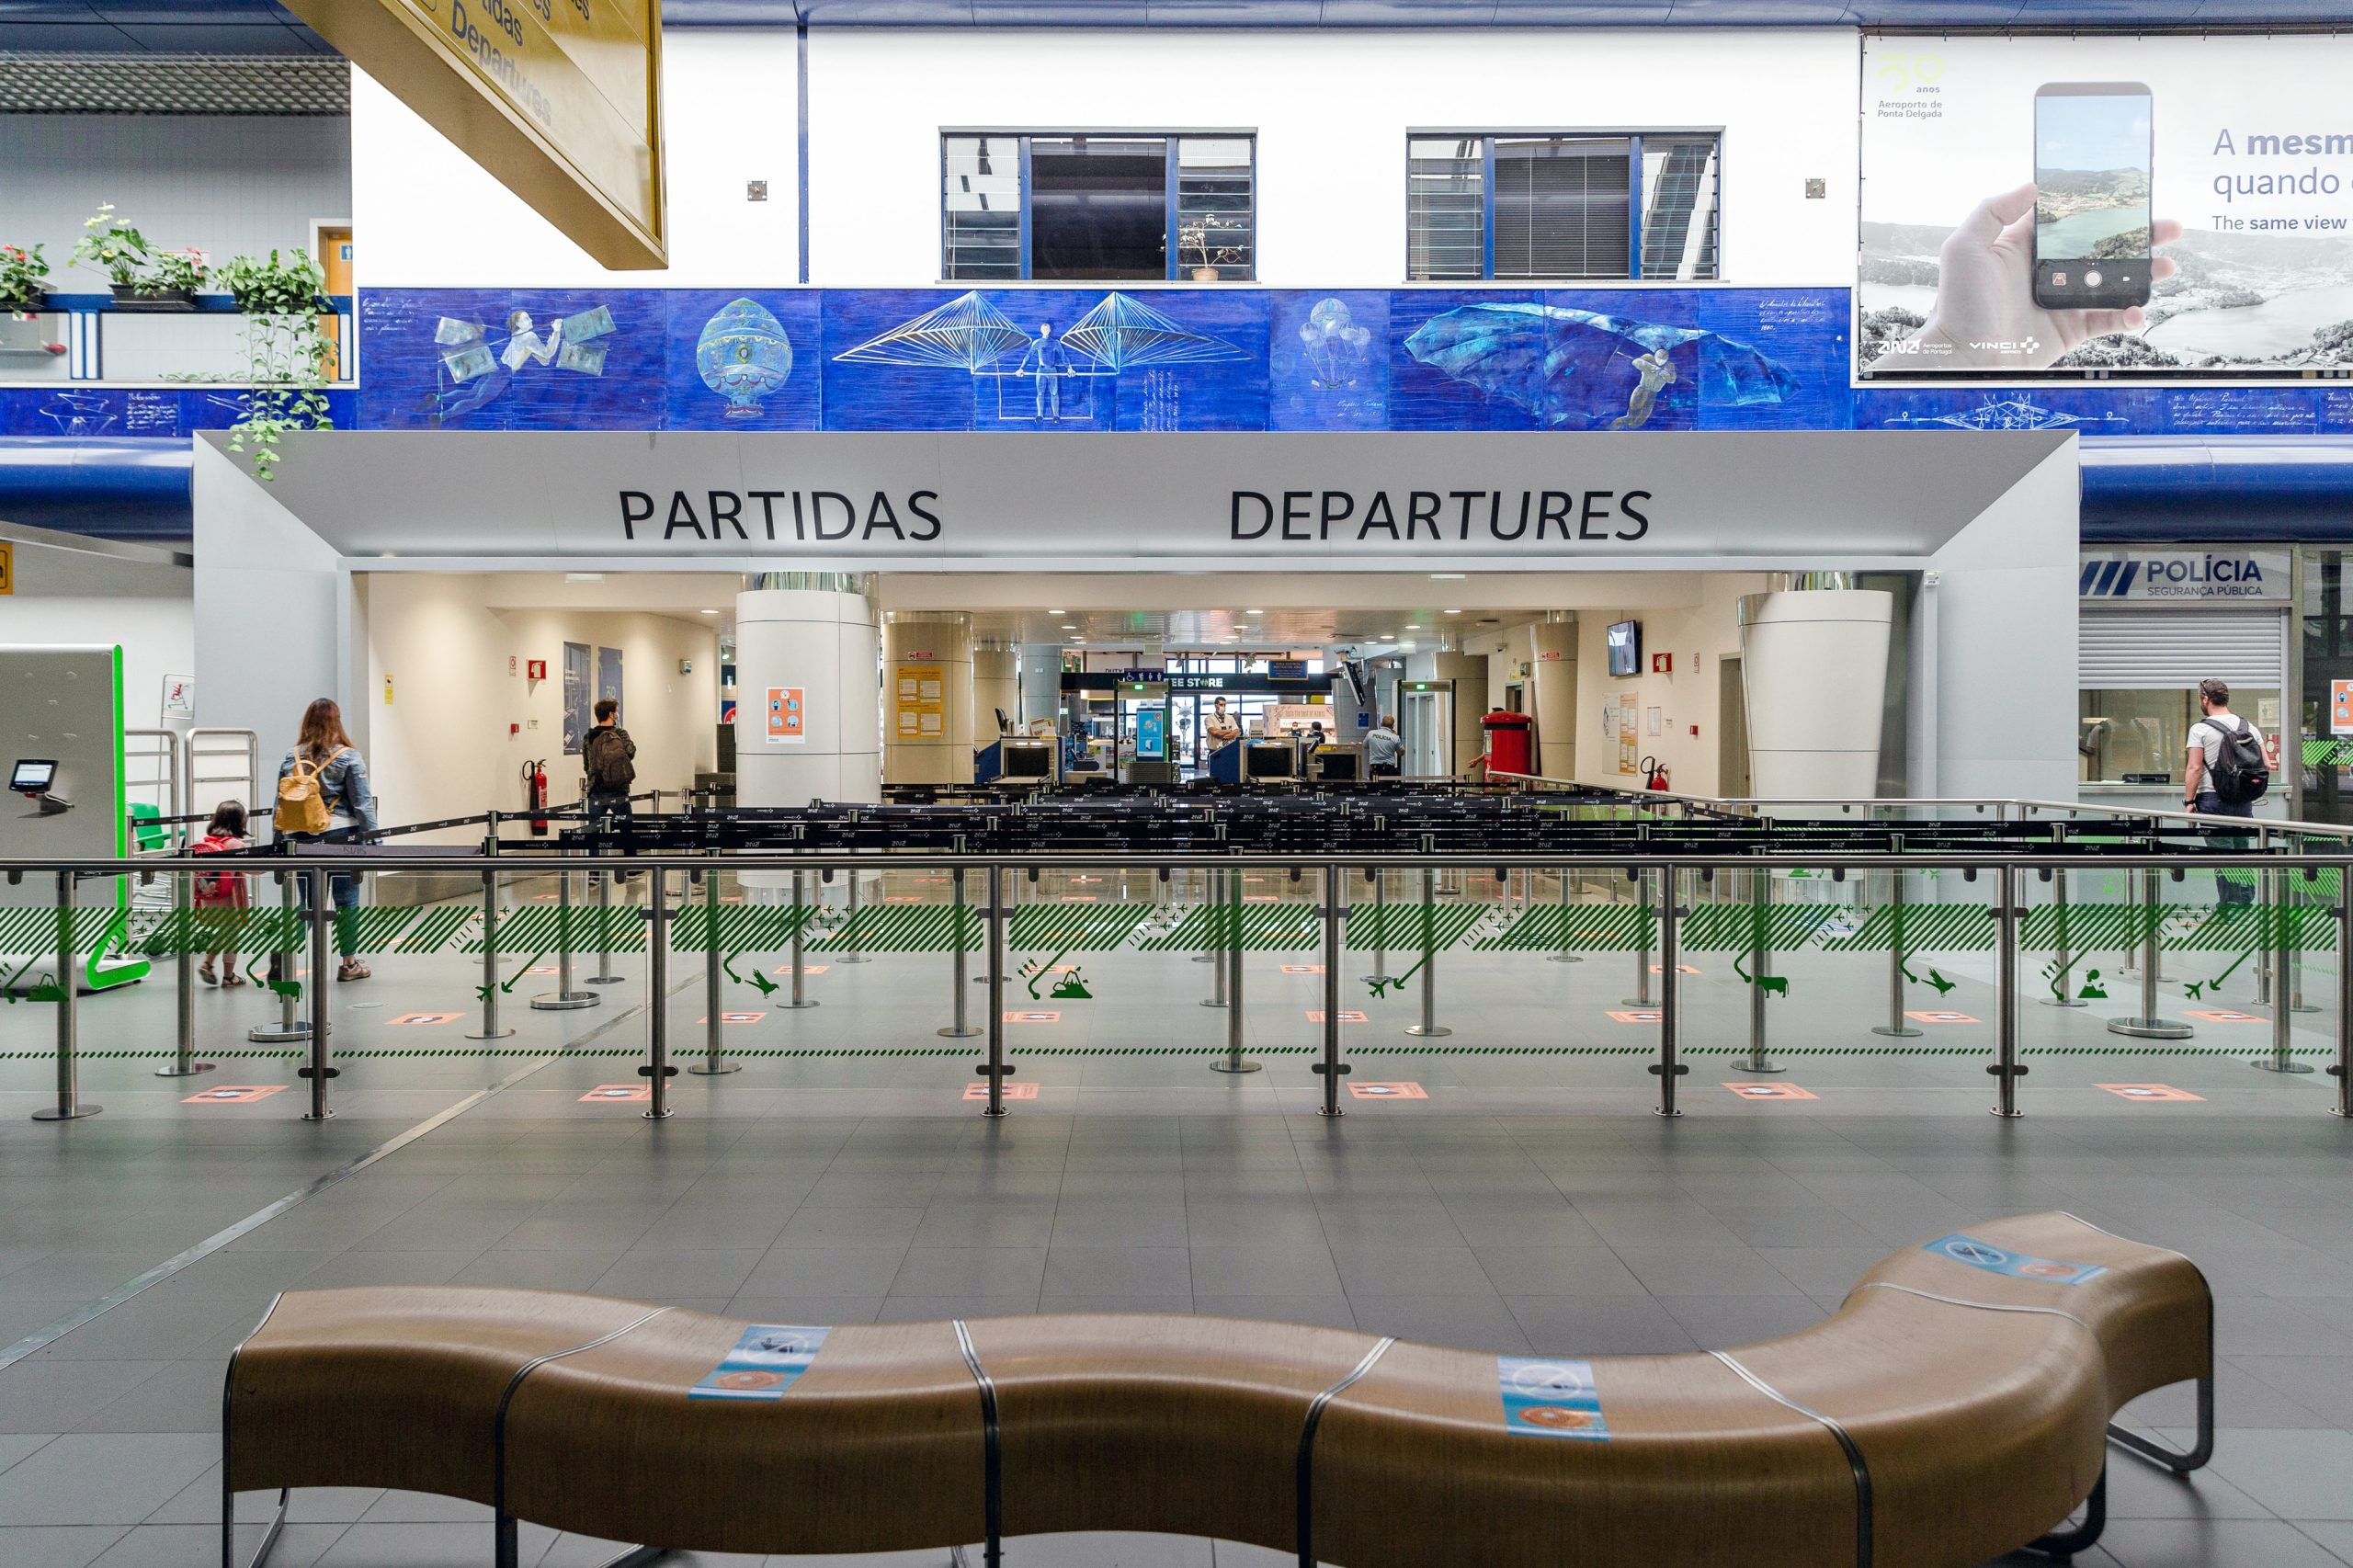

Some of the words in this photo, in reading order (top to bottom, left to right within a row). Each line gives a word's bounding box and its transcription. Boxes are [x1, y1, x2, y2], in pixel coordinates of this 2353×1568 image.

[451, 1, 551, 127] Departures
[1878, 100, 1927, 110] Aeroporto
[1930, 100, 1942, 108] de
[1878, 109, 1904, 118] Ponta
[1905, 109, 1942, 119] Delgada
[2213, 129, 2235, 155] A
[2213, 166, 2340, 203] quando
[2211, 215, 2245, 230] The
[2249, 218, 2299, 230] same
[2303, 214, 2347, 230] view
[619, 490, 942, 541] PARTIDAS
[1230, 490, 1653, 541] DEPARTURES
[2147, 554, 2263, 583] POLÍCIA
[2147, 586, 2215, 597] SEGURANÇA
[2217, 584, 2263, 596] PÚBLICA
